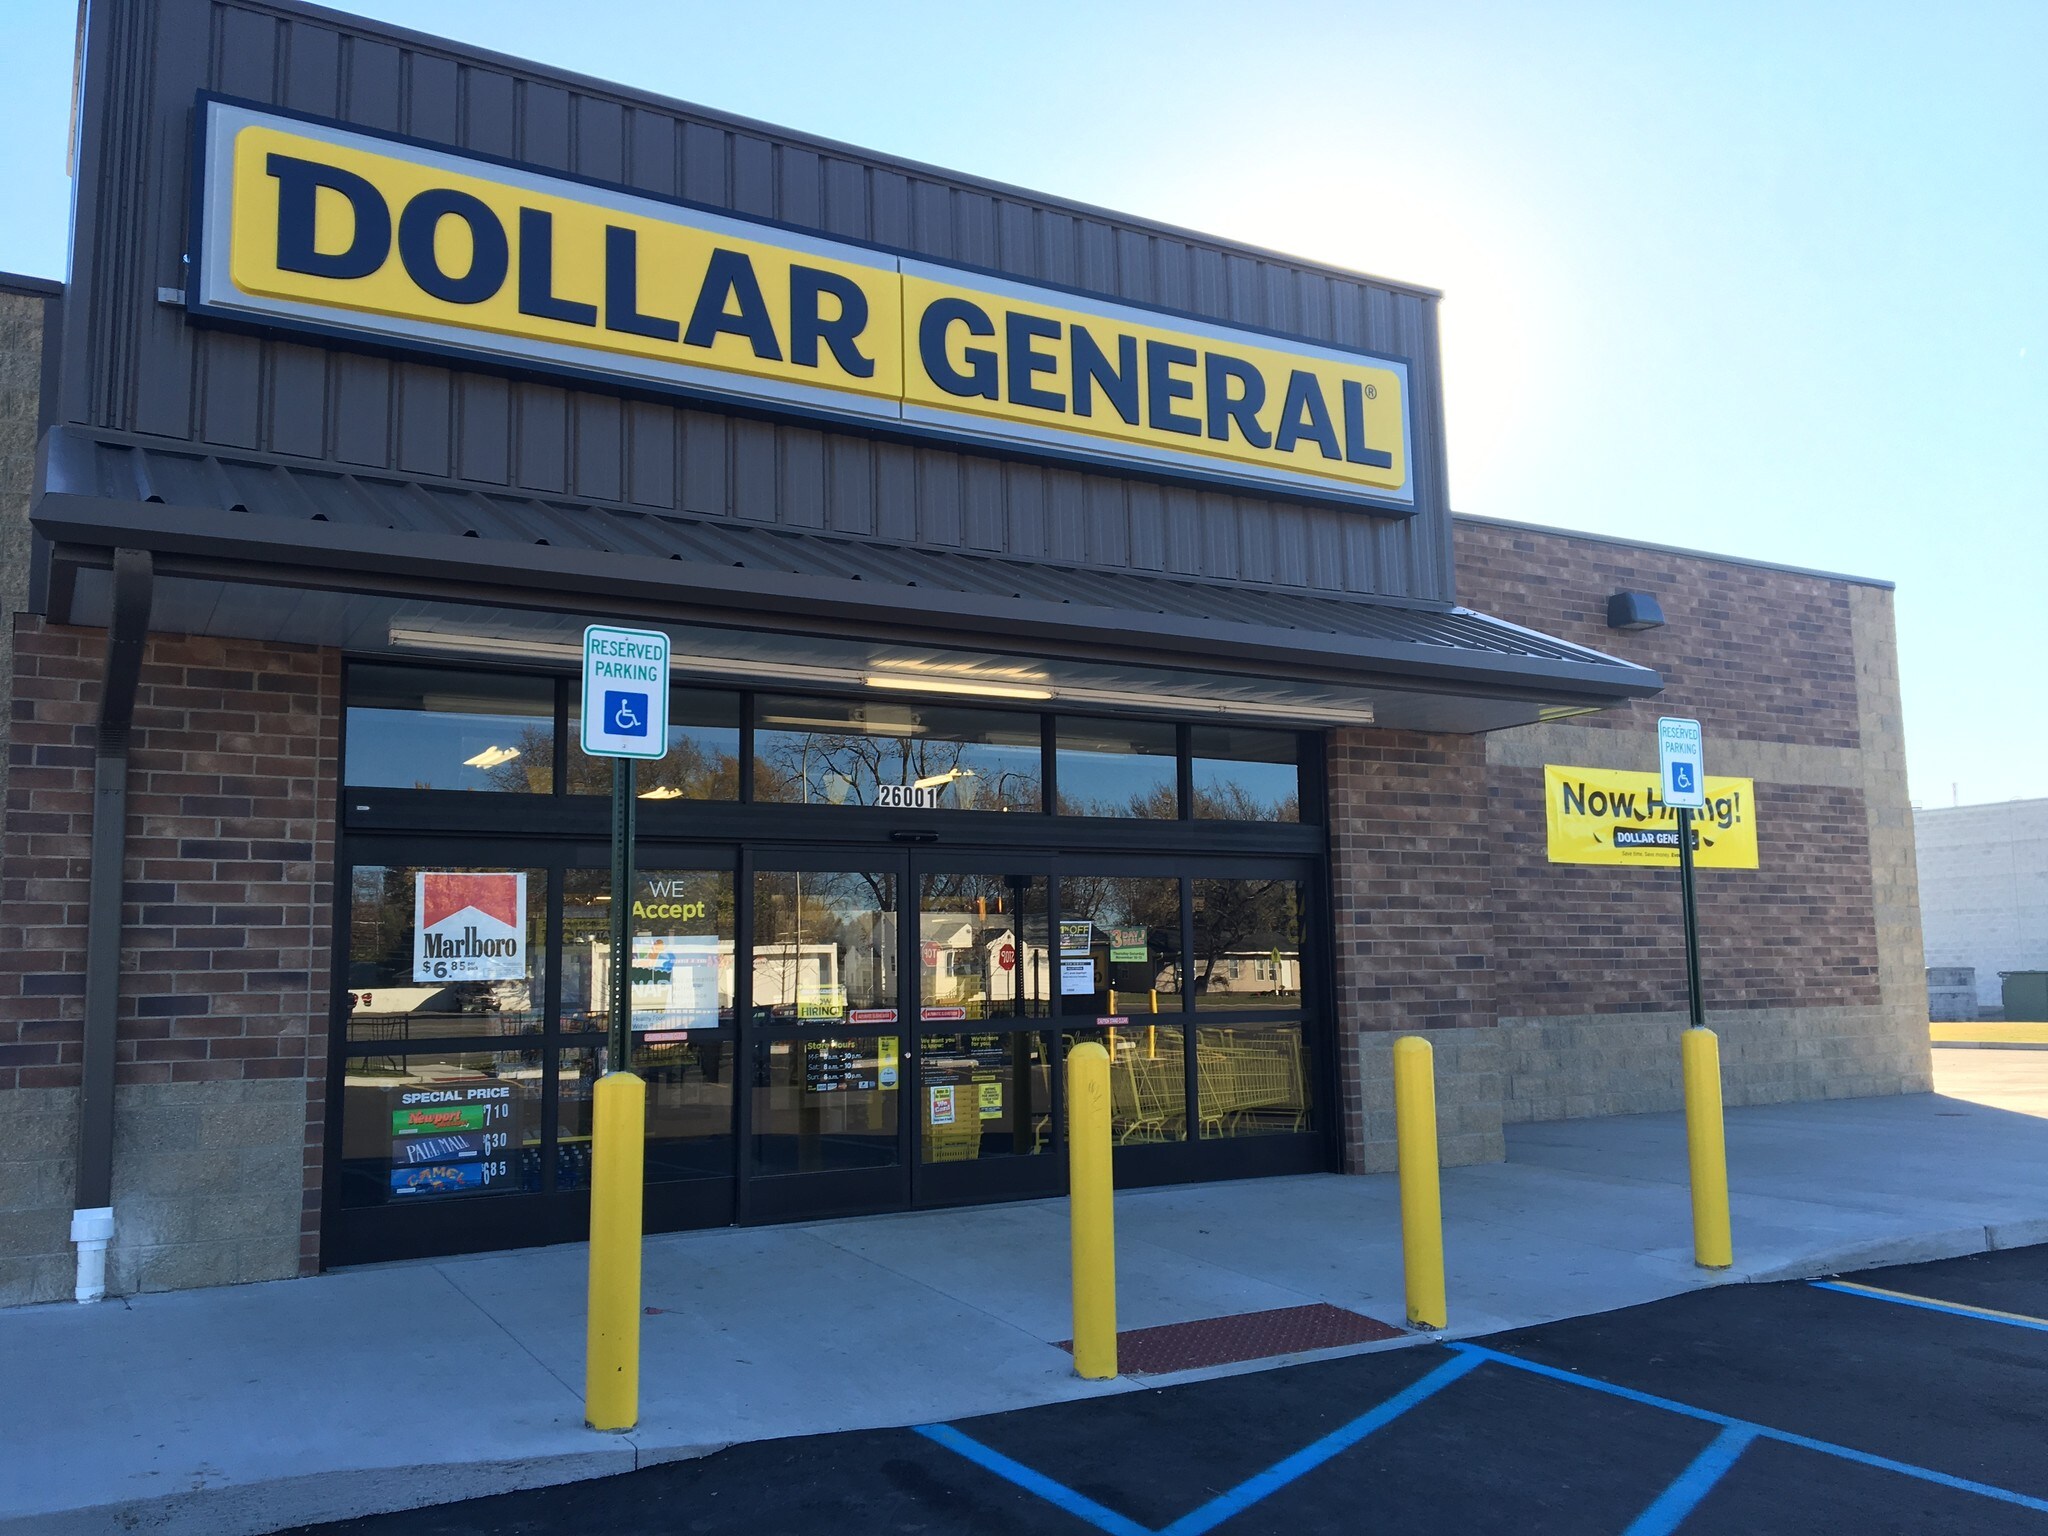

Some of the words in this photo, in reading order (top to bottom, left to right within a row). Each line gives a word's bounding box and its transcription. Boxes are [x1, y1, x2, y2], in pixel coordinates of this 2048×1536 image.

[266, 151, 875, 378] DOLLAR
[918, 297, 1392, 469] GENERAL
[591, 638, 663, 661] RESERVED
[595, 660, 658, 682] PARKING
[1662, 726, 1698, 741] RESERVED
[1665, 741, 1697, 755] PARKING
[880, 785, 935, 808] 26001
[1562, 781, 1636, 818] Now
[1647, 786, 1741, 829] Hng!
[1617, 832, 1655, 844] DOLLAR
[649, 881, 685, 898] WE
[632, 901, 706, 922] Accept
[1070, 925, 1089, 934] OFF
[1110, 929, 1123, 948] 3
[423, 926, 517, 959] Marlboro
[807, 1041, 830, 1050] Store
[402, 1090, 463, 1104] SPECIAL
[467, 1087, 510, 1099] PRICE
[408, 1110, 462, 1126] Newport
[406, 1141, 441, 1164] PALL
[438, 1135, 470, 1154] MALL
[407, 1167, 466, 1187] CAMEL
